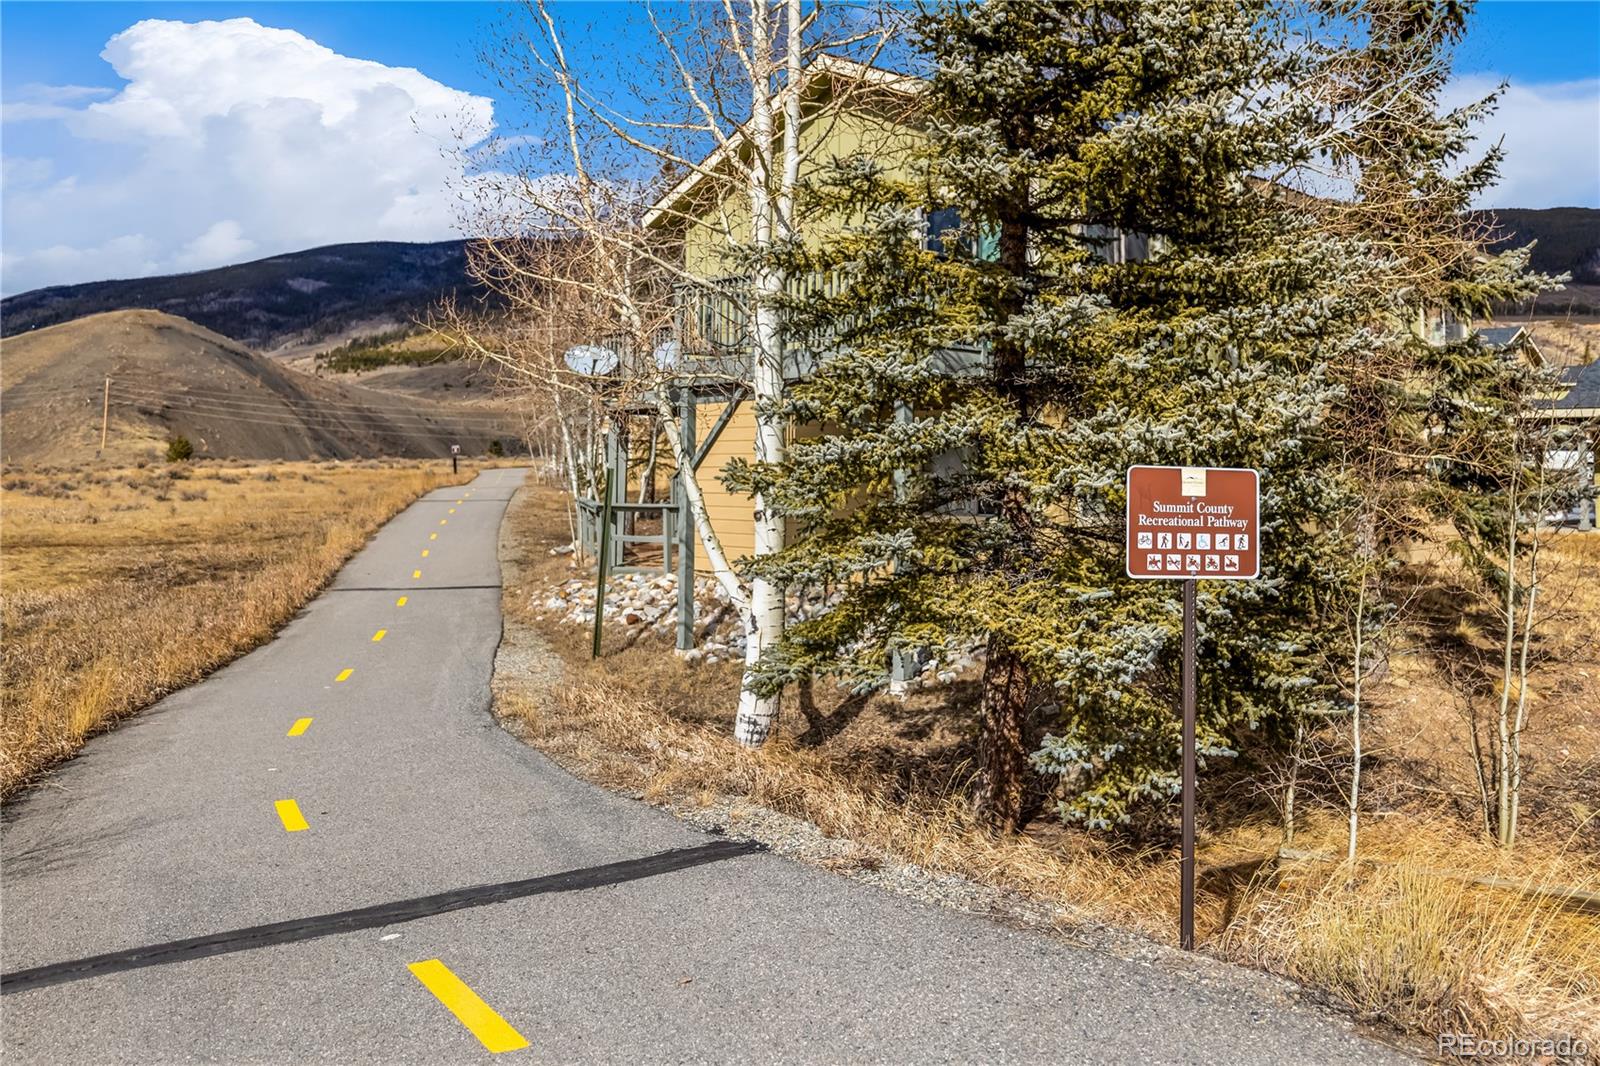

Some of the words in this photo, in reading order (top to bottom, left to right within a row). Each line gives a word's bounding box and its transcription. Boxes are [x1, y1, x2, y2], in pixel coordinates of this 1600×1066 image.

[1153, 501, 1194, 513] Summit
[1197, 502, 1234, 517] County
[1138, 514, 1204, 527] Recreational
[1207, 516, 1248, 531] Pathway
